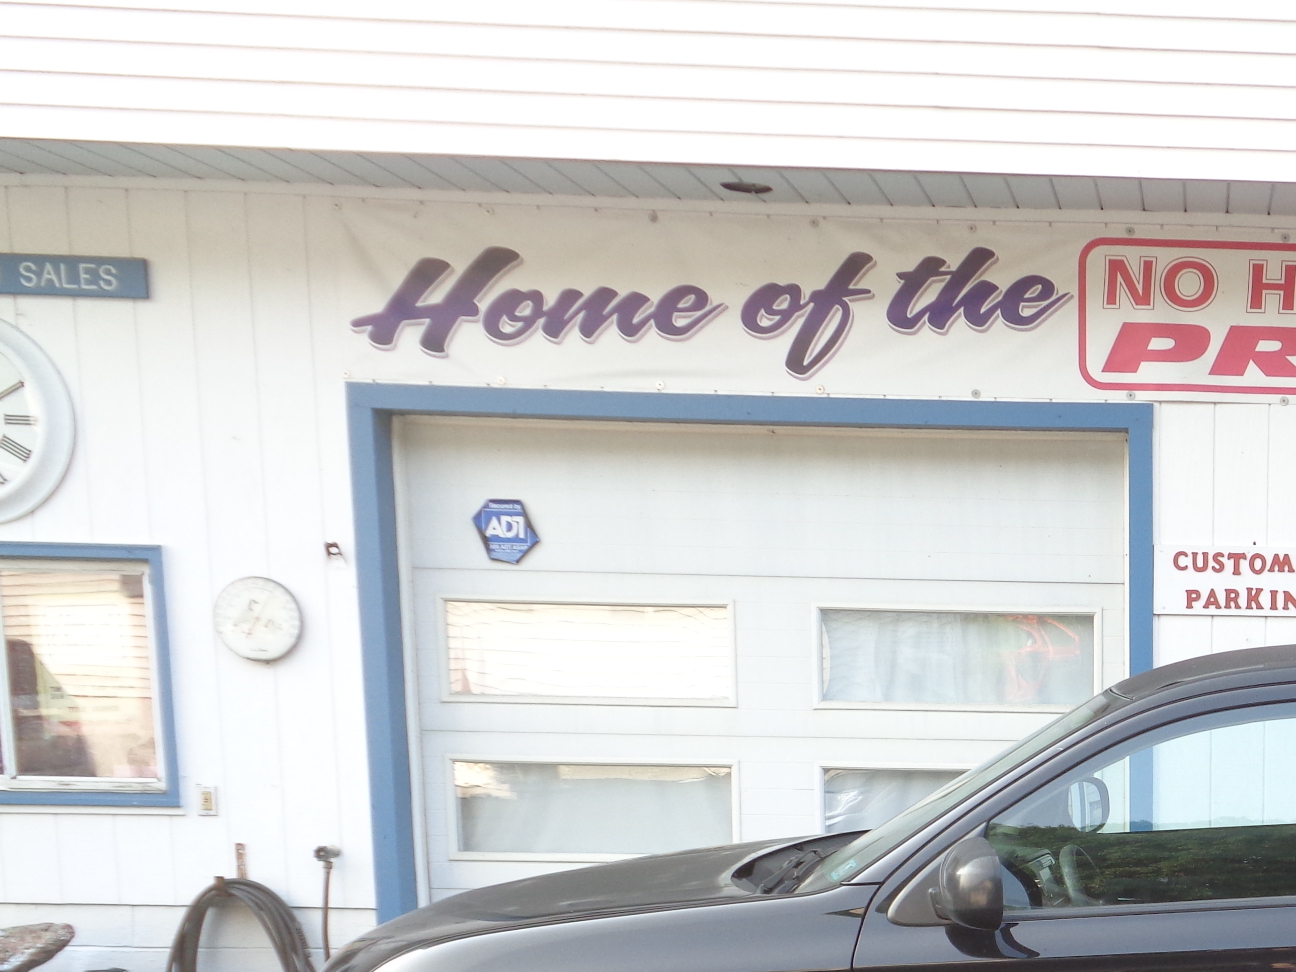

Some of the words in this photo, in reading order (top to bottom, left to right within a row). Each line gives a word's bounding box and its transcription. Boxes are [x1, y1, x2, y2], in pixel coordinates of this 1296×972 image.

[18, 261, 118, 291] SALES
[1102, 254, 1219, 312] NO
[350, 245, 728, 358] Home
[739, 251, 878, 381] of
[884, 245, 1074, 335] the
[485, 514, 525, 539] ADT
